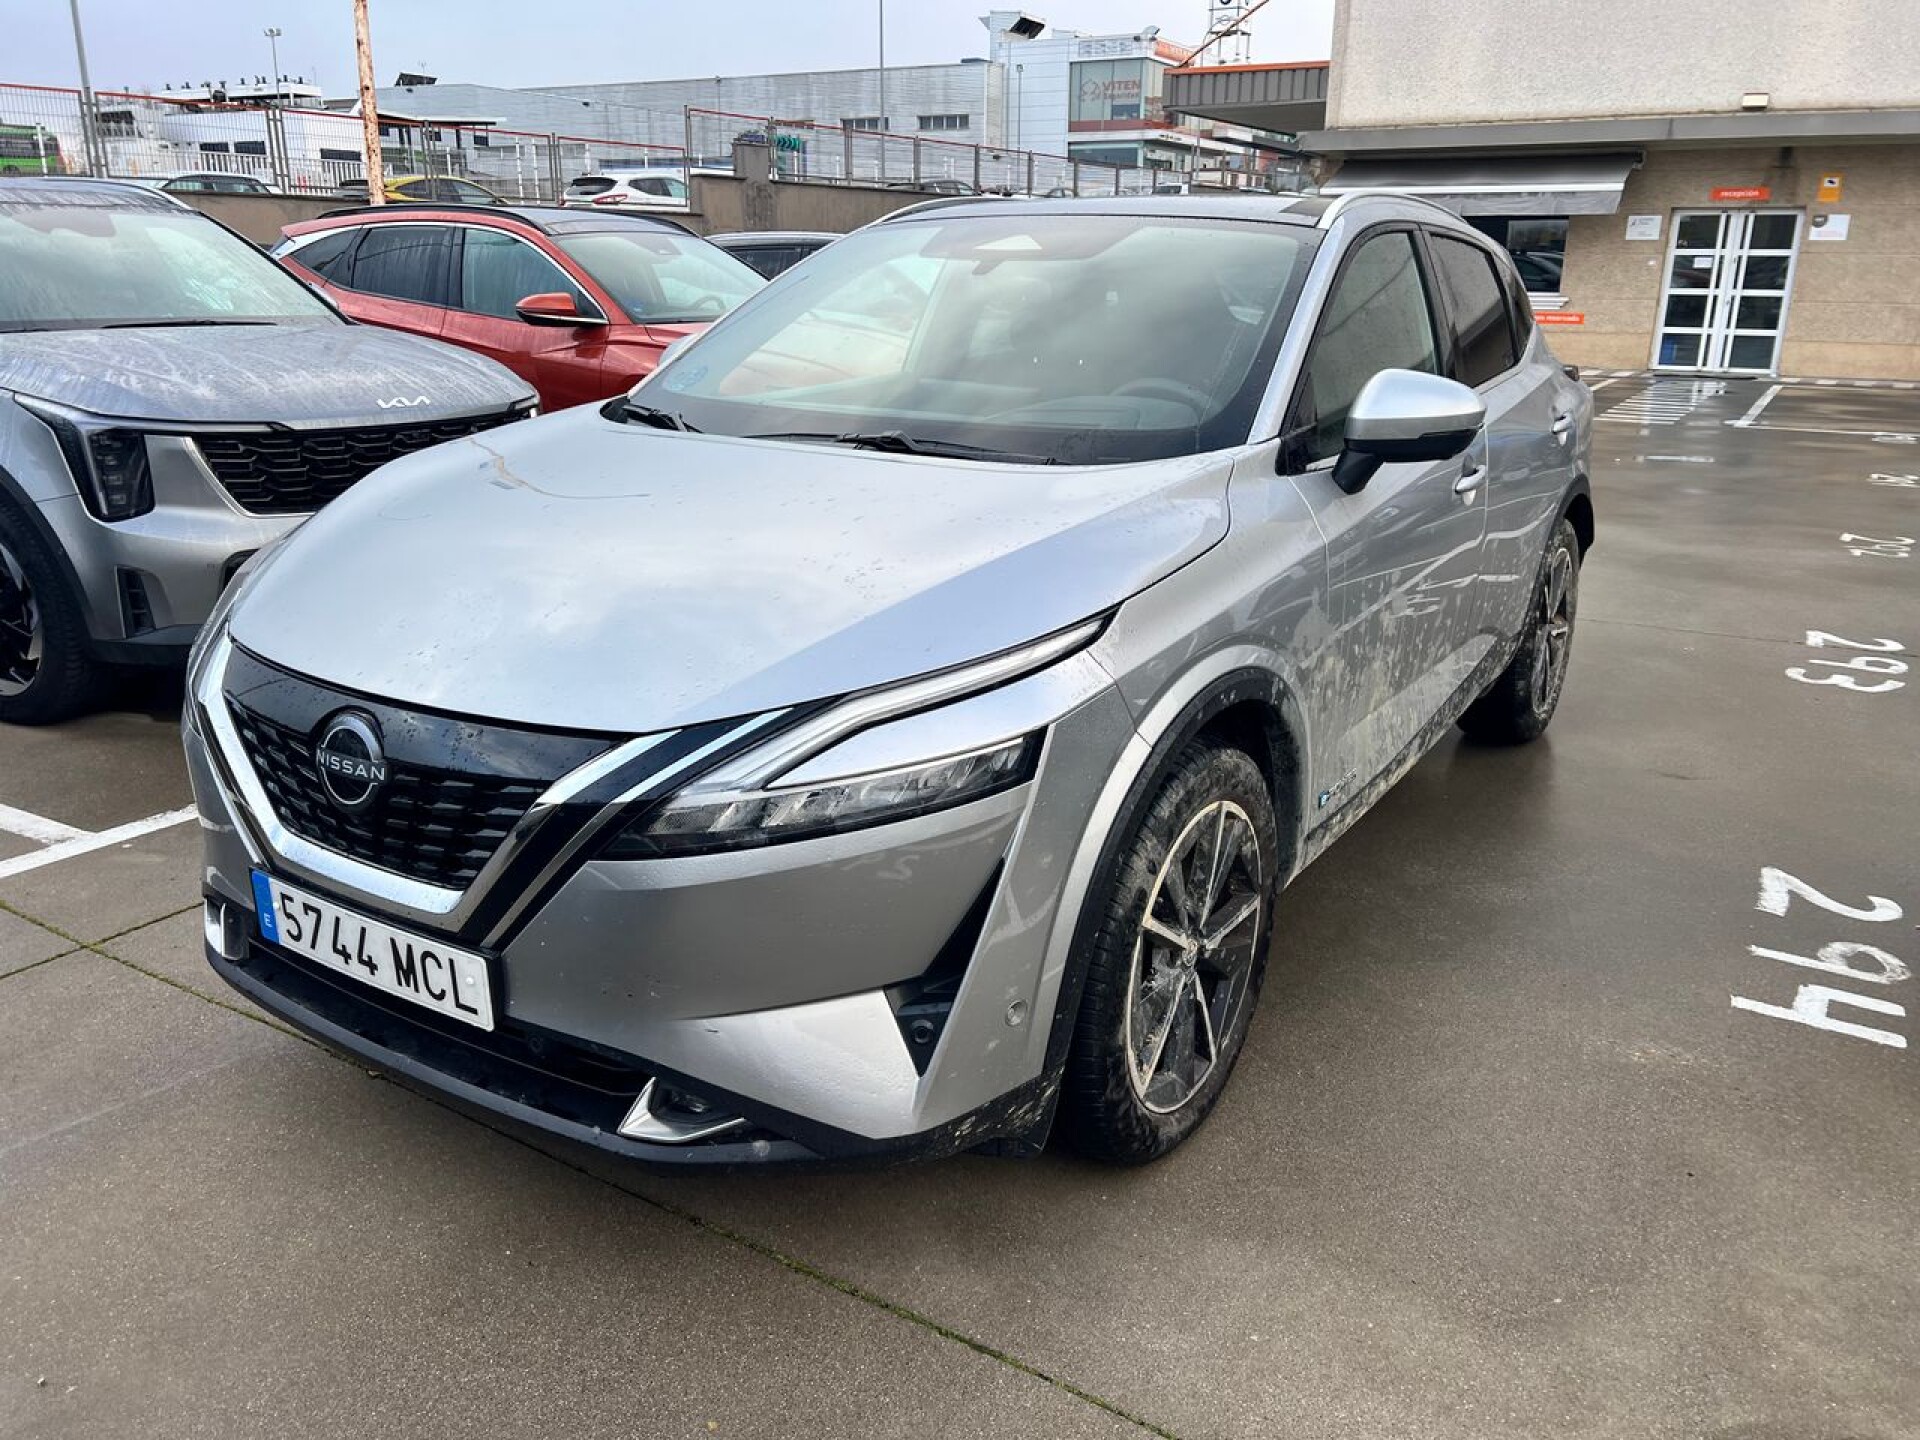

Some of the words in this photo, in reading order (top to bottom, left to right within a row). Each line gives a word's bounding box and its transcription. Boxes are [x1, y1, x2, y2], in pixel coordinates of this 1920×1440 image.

[1784, 630, 1909, 692] 293
[316, 748, 385, 781] NISSAN
[280, 891, 379, 976] 5744
[389, 936, 479, 1016] MCL
[1728, 866, 1912, 1049] 294
